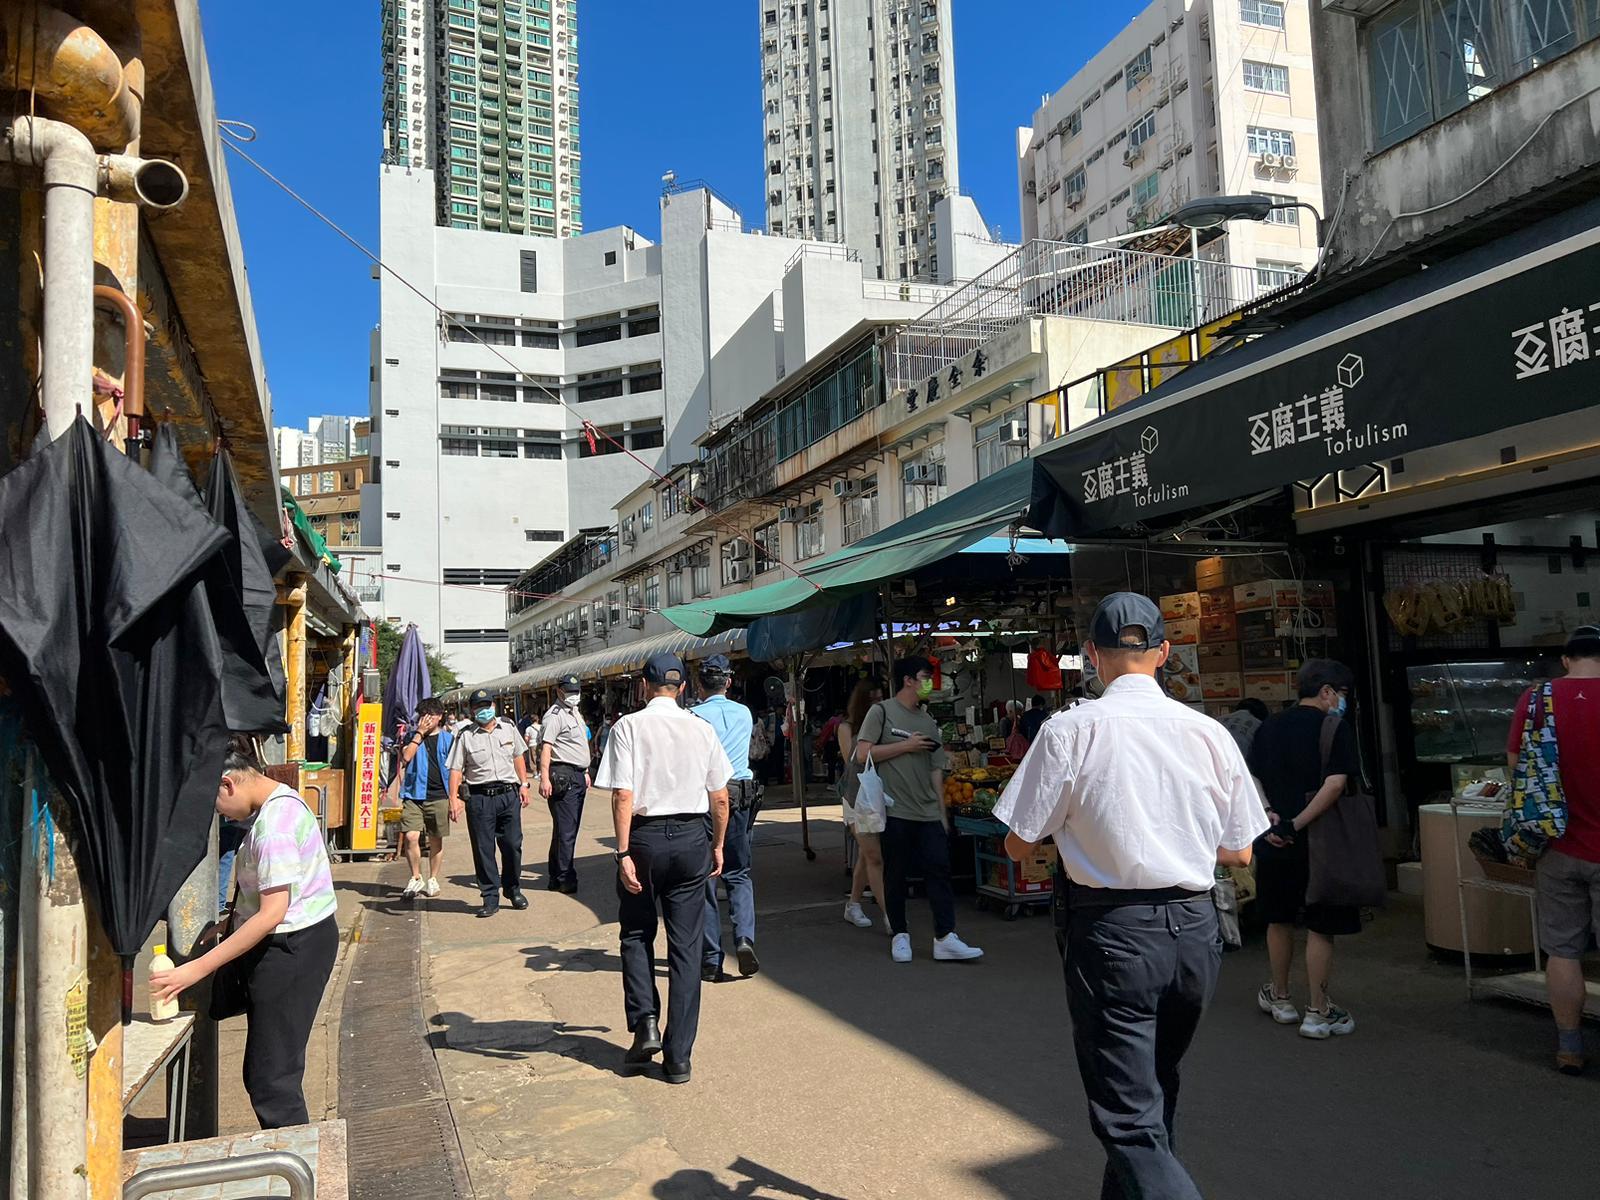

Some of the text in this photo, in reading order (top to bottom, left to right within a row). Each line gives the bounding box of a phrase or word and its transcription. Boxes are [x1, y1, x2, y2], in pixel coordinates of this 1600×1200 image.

[1248, 384, 1346, 456] 豆腐主義
[1324, 423, 1408, 456] Tofulism
[1081, 450, 1149, 504] 豆腐主義
[1132, 483, 1190, 507] Tofulism
